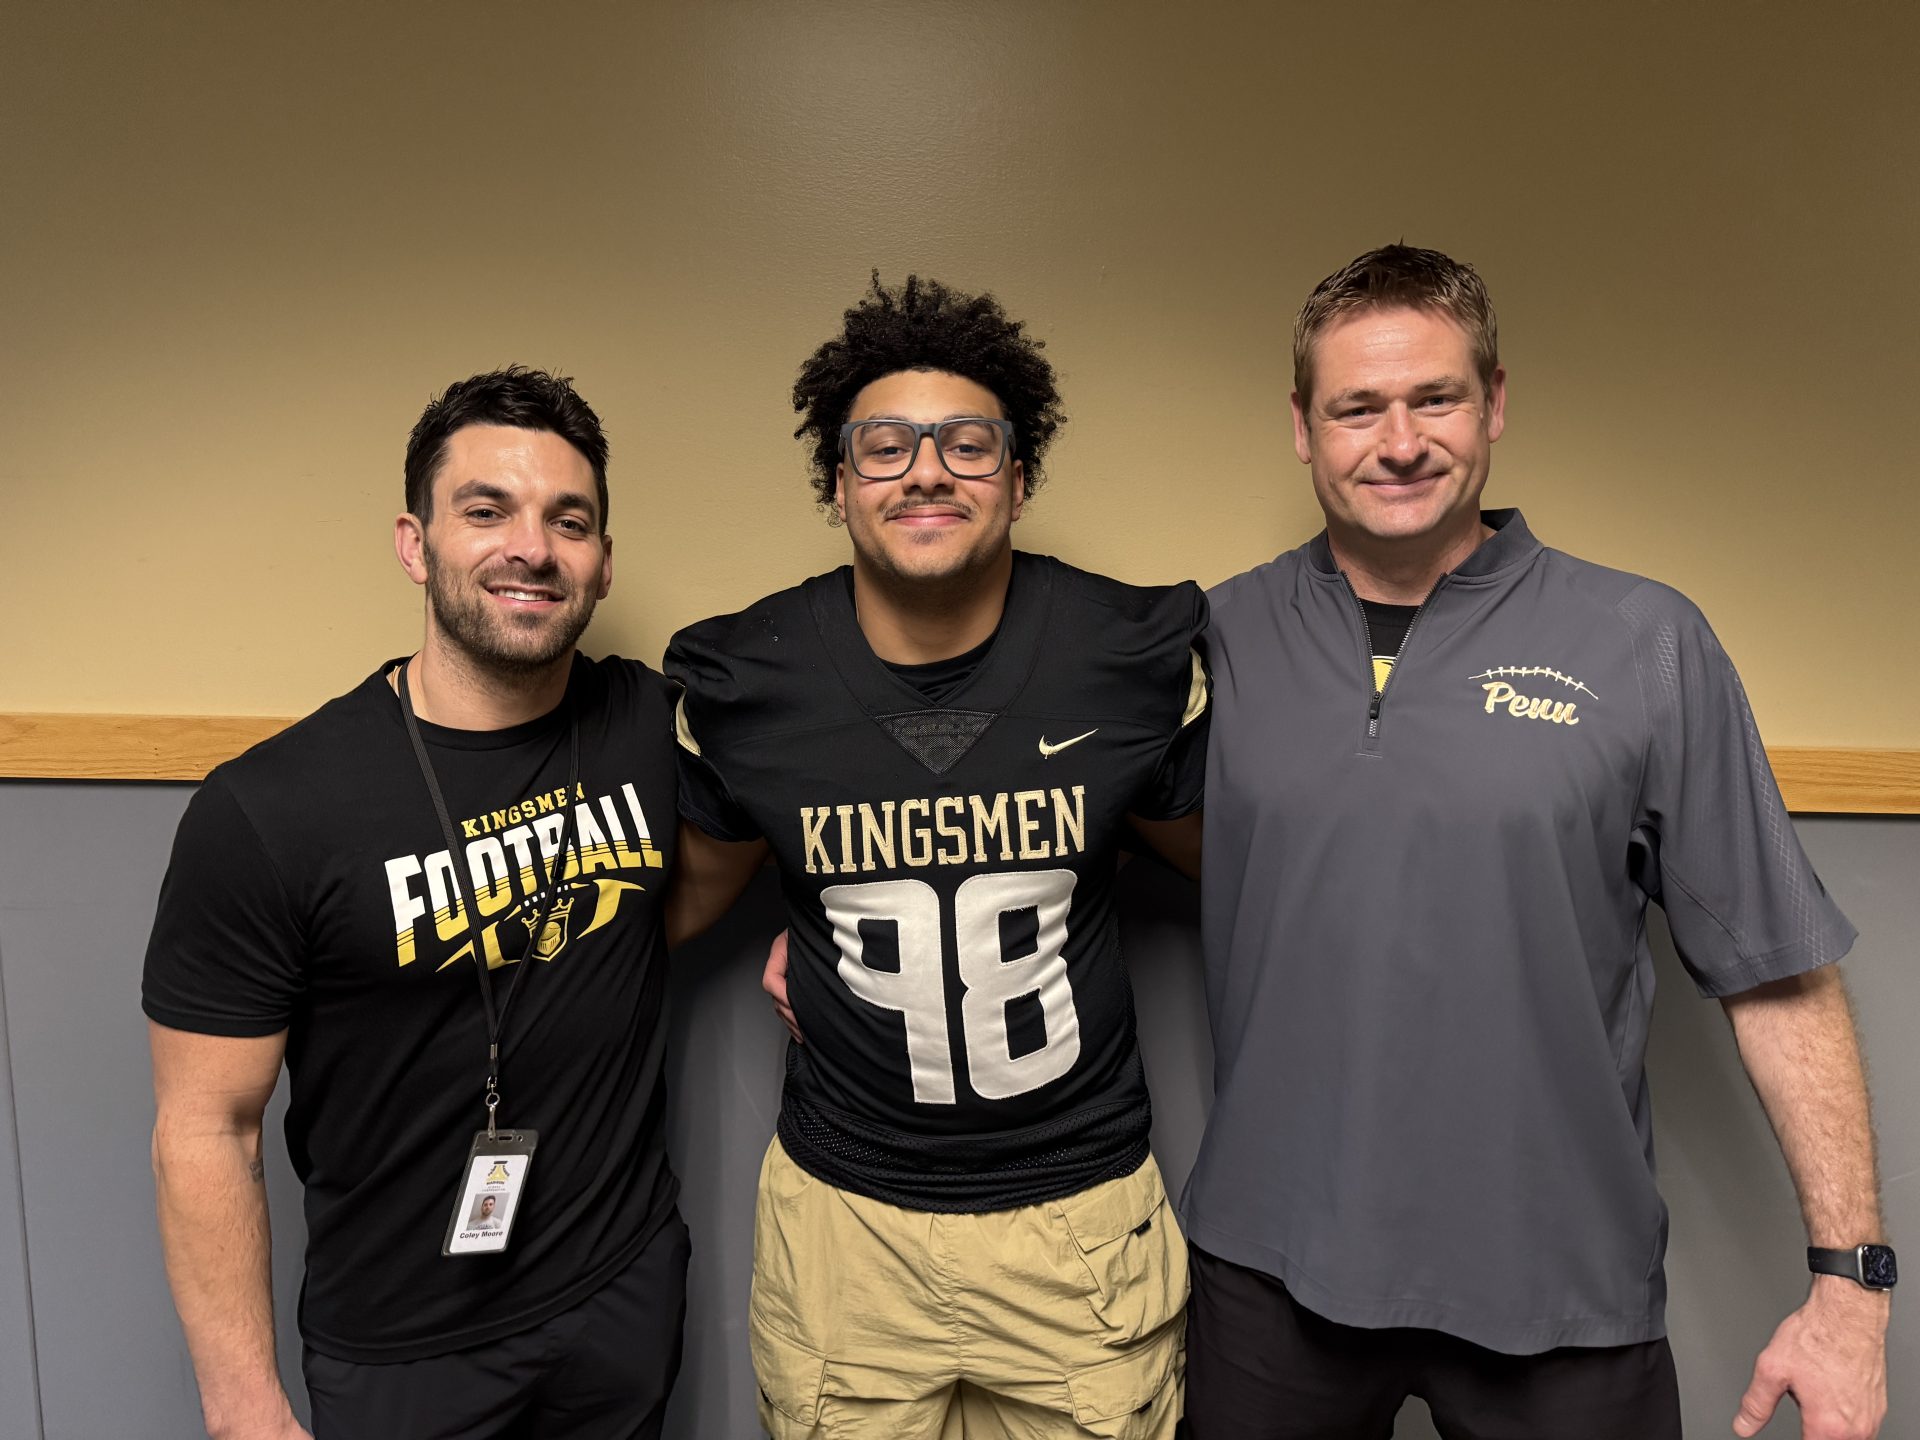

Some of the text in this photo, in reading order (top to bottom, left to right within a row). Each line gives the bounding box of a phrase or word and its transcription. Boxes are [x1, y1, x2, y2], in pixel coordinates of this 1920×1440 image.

[1482, 681, 1579, 725] Penn
[384, 783, 663, 967] FOOTBALL
[800, 786, 1085, 874] KINGSMEN
[820, 868, 1081, 1104] 98
